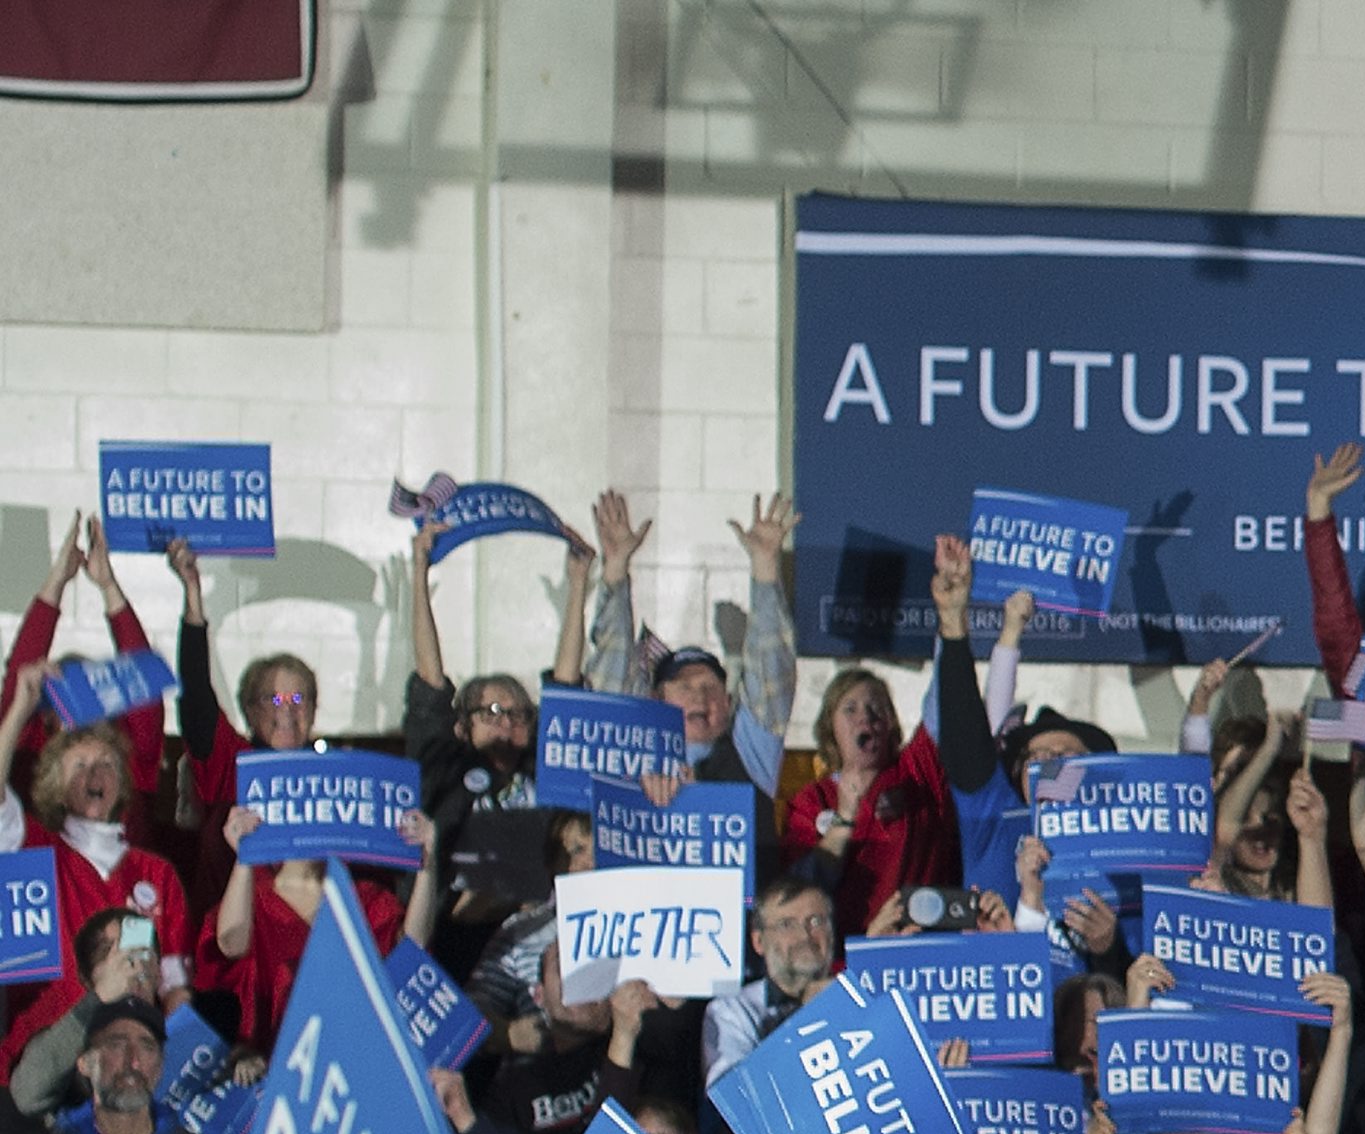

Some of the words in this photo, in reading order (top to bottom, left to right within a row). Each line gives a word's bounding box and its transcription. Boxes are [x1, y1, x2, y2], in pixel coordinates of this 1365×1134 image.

[824, 343, 891, 424] A
[920, 346, 1310, 436] FUTURE
[130, 468, 223, 492] FUTURE
[230, 470, 264, 492] TO
[107, 494, 226, 520] BELIEVE
[234, 494, 266, 521] IN
[991, 514, 1076, 549] FUTURE
[1082, 532, 1114, 557] TO
[1077, 556, 1108, 583] IN
[546, 715, 563, 739] A
[569, 719, 655, 748] FUTURE
[660, 725, 684, 754] TO
[545, 741, 656, 778] BELIEVE
[379, 780, 415, 806] TO
[614, 805, 700, 836] FUTURE
[708, 814, 746, 835] TO
[1040, 807, 1171, 836] BELIEVE
[1179, 809, 1208, 834] IN
[598, 824, 703, 866] BELIEVE
[712, 841, 747, 866] IN
[7, 880, 48, 905] TO
[12, 906, 52, 936] IN
[1154, 911, 1172, 934] A
[1177, 914, 1281, 950] FUTURE
[1288, 931, 1328, 955] TO
[566, 905, 732, 969] TOGETHER
[1153, 937, 1286, 979] BELIEVE
[407, 965, 437, 996] TO
[1002, 962, 1043, 989] TO
[429, 982, 458, 1019] IN
[1007, 992, 1043, 1020] IN
[287, 1014, 321, 1103] A
[840, 1028, 875, 1059] A
[1107, 1041, 1126, 1064] A
[1133, 1040, 1246, 1067] FUTURE
[1252, 1047, 1290, 1071] TO
[1106, 1067, 1248, 1097] BELIEVE
[1256, 1073, 1290, 1102] IN
[1042, 1102, 1077, 1129] TO
